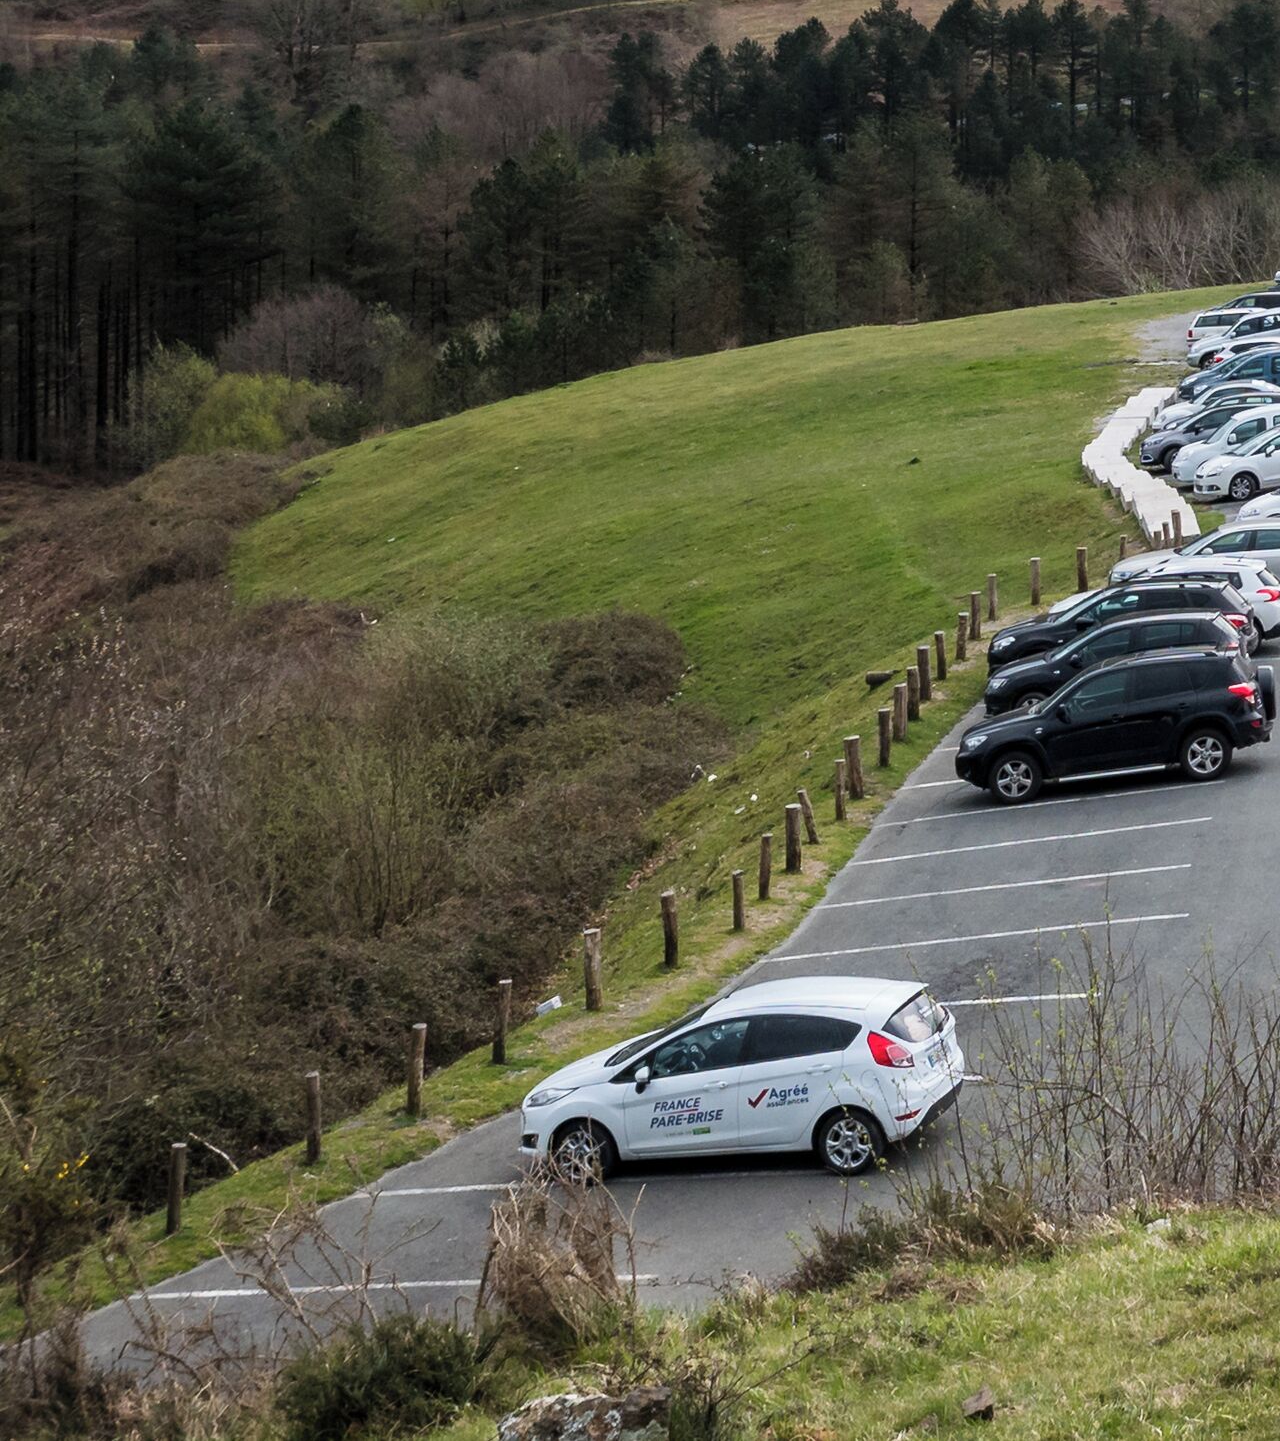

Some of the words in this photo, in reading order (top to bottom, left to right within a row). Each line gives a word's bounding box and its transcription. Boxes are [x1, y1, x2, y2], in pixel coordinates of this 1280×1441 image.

[768, 1083, 809, 1101] Agréé
[653, 1097, 701, 1113] FRANCE
[766, 1097, 809, 1108] assurances
[650, 1109, 724, 1129] PARE-BRISE
